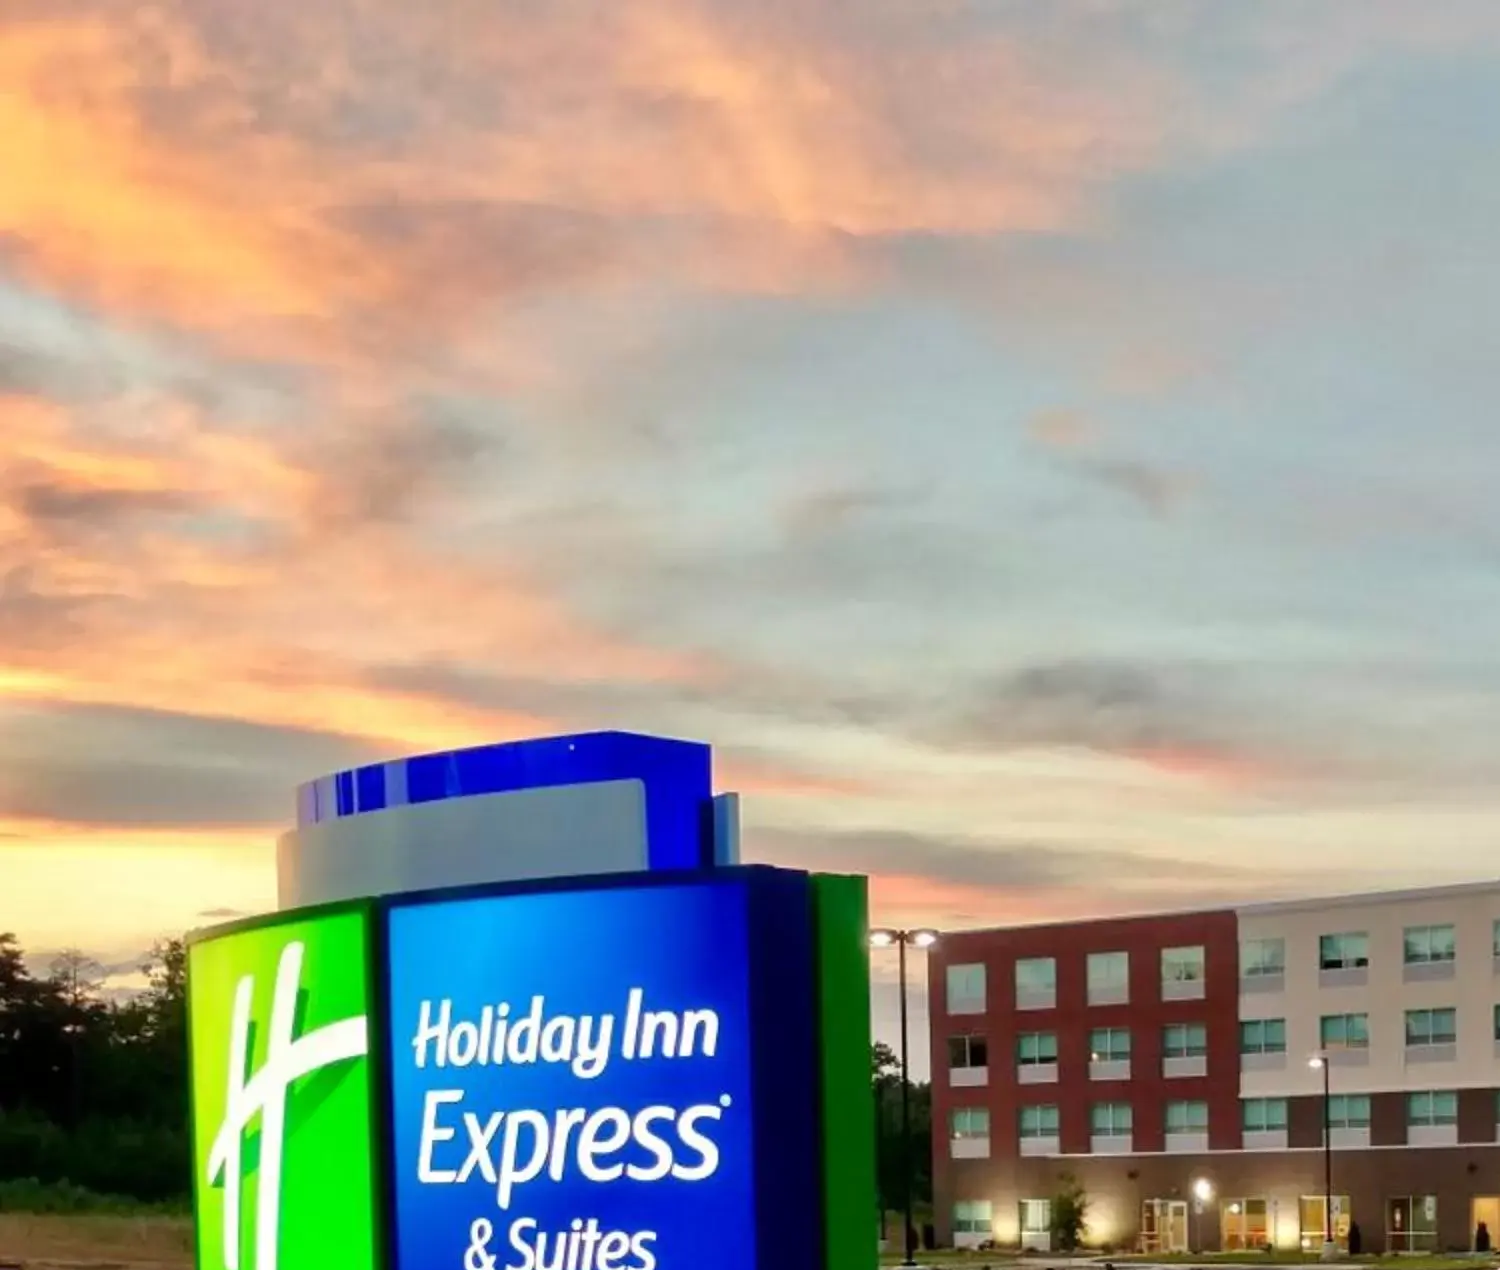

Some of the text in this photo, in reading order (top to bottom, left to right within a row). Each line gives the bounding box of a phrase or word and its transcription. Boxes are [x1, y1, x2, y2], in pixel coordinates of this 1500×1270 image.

[411, 987, 719, 1079] Holiday Inn
[417, 1088, 722, 1211] Express
